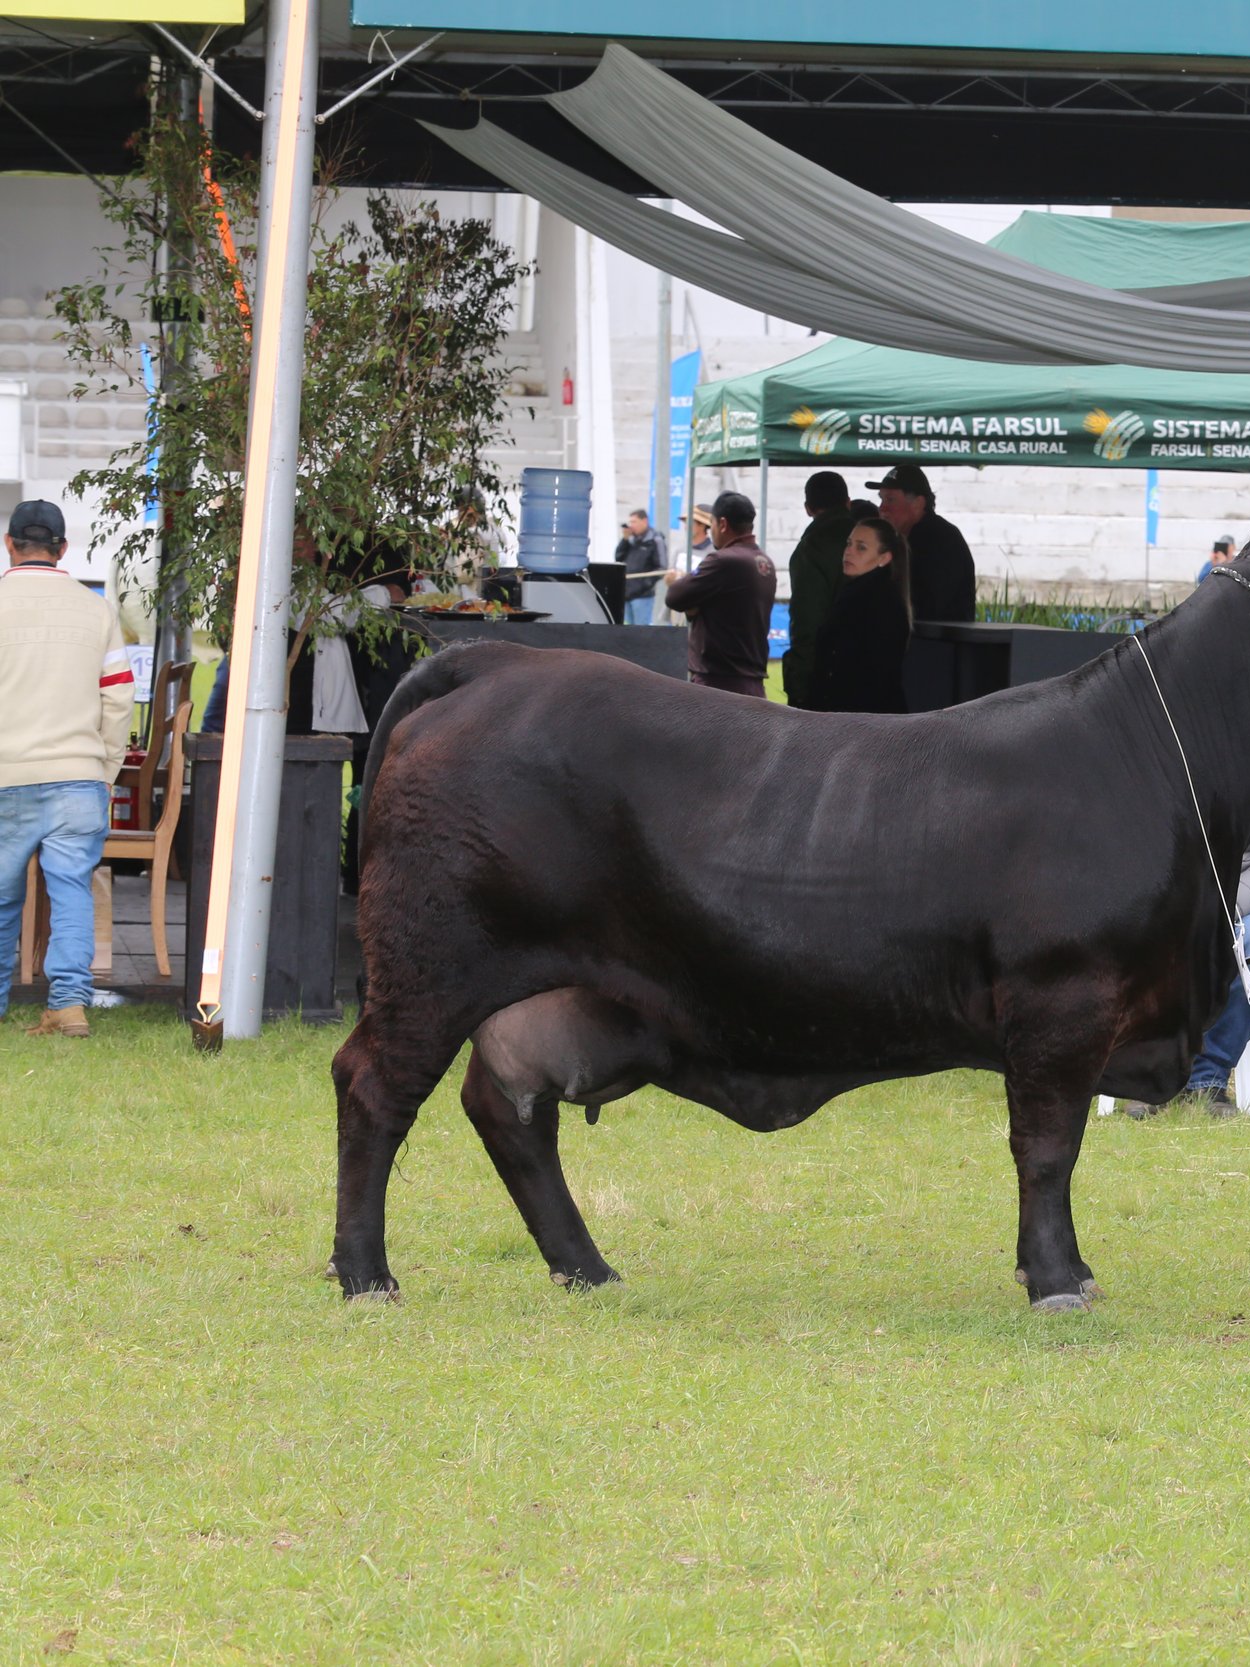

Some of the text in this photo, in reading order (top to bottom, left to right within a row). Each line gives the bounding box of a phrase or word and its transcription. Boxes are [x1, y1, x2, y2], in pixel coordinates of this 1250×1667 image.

[859, 414, 1068, 436] SISTEMA FARSUL
[858, 439, 1067, 454] FARSUL SENAR CASA RURAL
[1151, 444, 1205, 457] FARSUL
